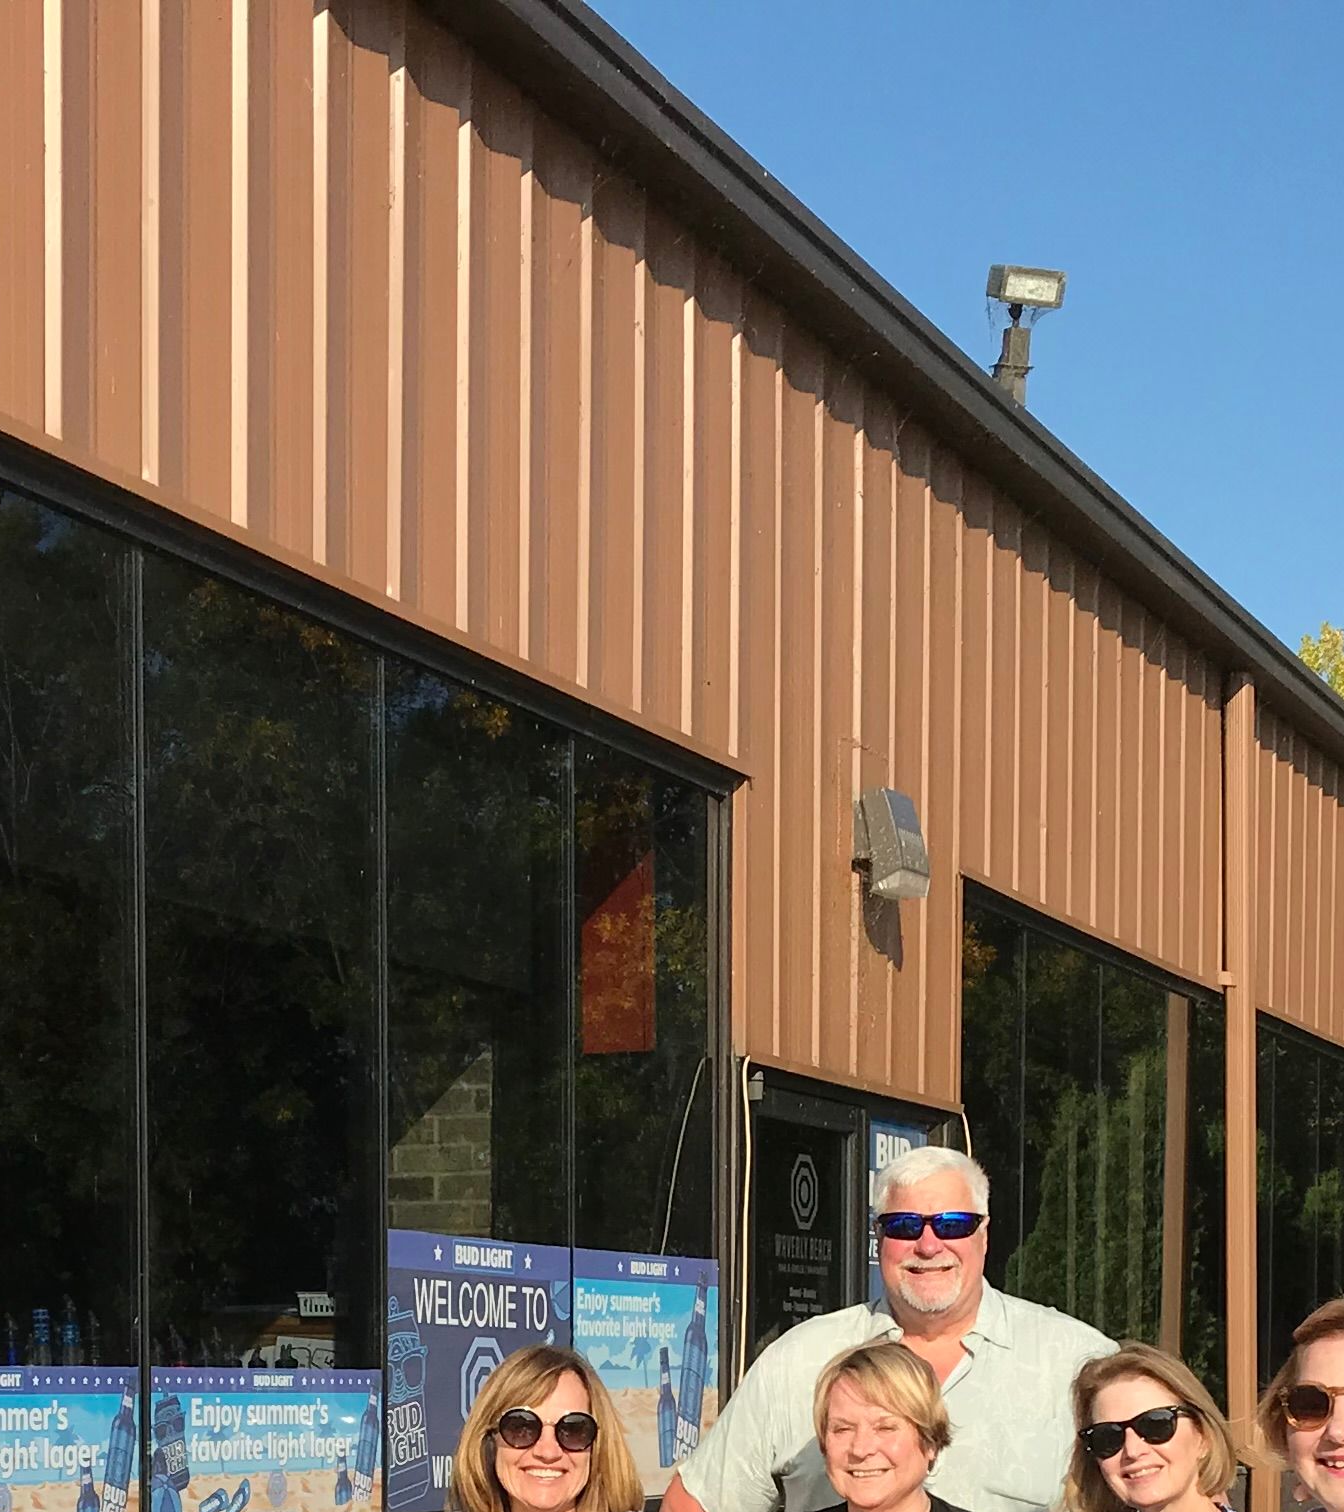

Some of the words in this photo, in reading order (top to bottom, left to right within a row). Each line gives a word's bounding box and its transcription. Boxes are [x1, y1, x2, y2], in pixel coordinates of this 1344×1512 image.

[455, 1245, 479, 1266] BUD
[480, 1249, 513, 1269] LIGHT
[630, 1261, 646, 1275] BUD
[647, 1262, 668, 1277] LIGHT
[413, 1278, 517, 1329] WELCOME
[521, 1286, 548, 1331] TO
[576, 1287, 608, 1315] Enjoy
[610, 1292, 660, 1313] summer's
[576, 1313, 621, 1337] favorite
[622, 1315, 647, 1343] light
[649, 1317, 678, 1343] lager.
[254, 1375, 270, 1387] BUD
[271, 1375, 294, 1387] LIGHT
[191, 1397, 243, 1432] Enjoy
[247, 1397, 329, 1426] summer's
[676, 1415, 698, 1449] BUD
[44, 1438, 104, 1476] lager.
[190, 1433, 263, 1462] favorite
[268, 1431, 306, 1465] light
[310, 1431, 356, 1463] lager.
[103, 1482, 127, 1506] BUD
